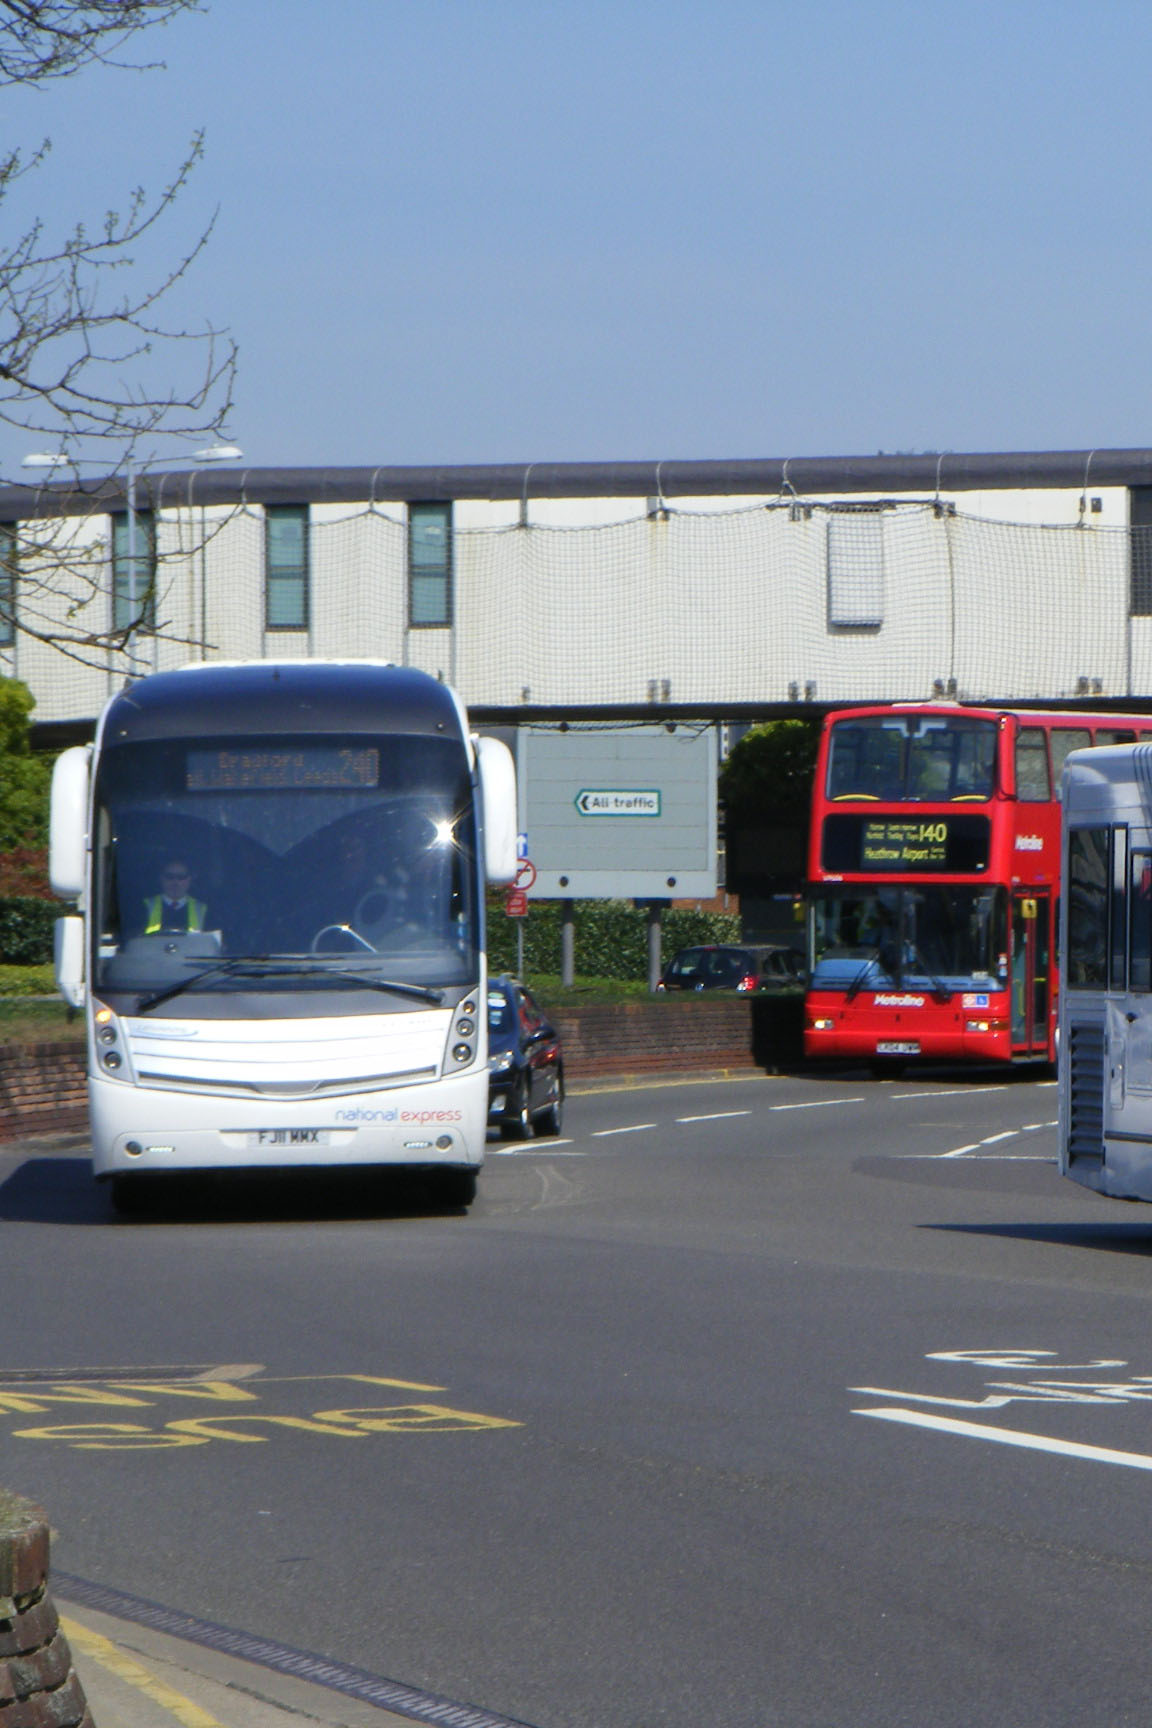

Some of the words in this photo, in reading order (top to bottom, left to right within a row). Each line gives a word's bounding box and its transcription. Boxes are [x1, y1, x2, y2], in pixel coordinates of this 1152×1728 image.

[592, 797, 609, 808] All
[614, 797, 655, 808] traffic
[919, 823, 947, 842] 140
[902, 846, 929, 862] Airport
[873, 993, 925, 1007] Metroline
[335, 1108, 398, 1121] national
[401, 1108, 462, 1124] express
[258, 1131, 286, 1144] FJ11
[0, 1374, 449, 1414] LAN
[12, 1404, 526, 1449] BUS
